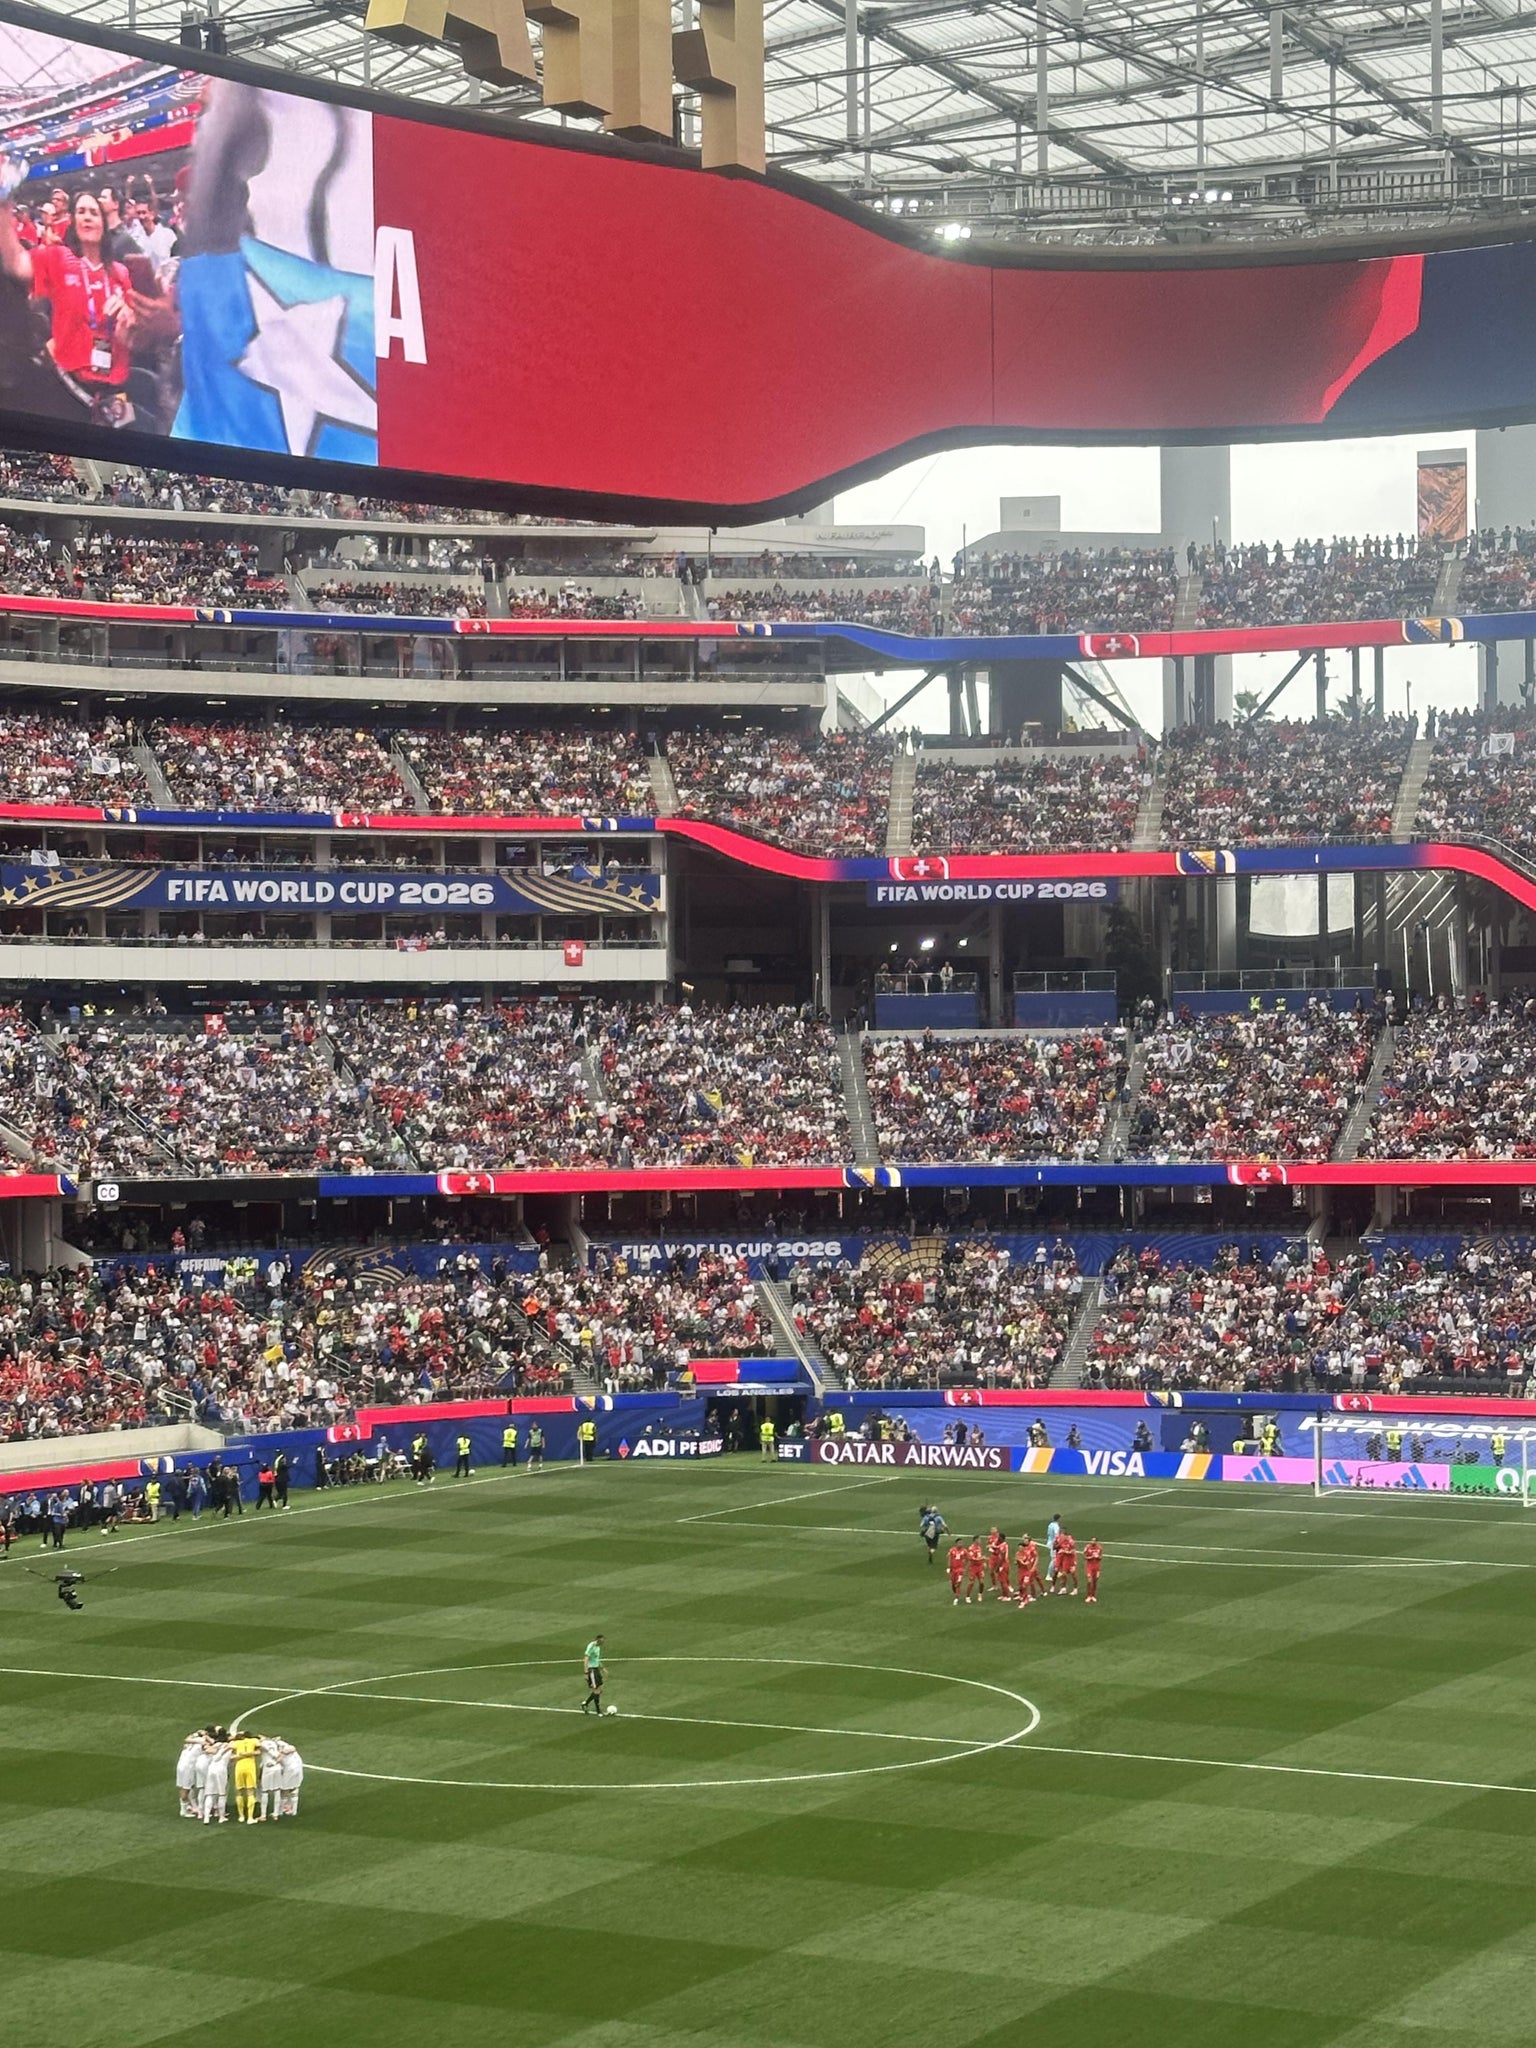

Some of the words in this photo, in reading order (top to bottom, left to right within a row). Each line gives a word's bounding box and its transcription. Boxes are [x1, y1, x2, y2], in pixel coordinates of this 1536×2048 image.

[374, 225, 427, 364] A
[167, 879, 229, 902] FIFA
[232, 880, 335, 903] WORLD
[339, 882, 394, 904] CUP
[399, 883, 495, 905] 2026
[876, 885, 918, 901] FIFA
[921, 883, 992, 900] WORLD
[995, 883, 1035, 899] CUP
[1037, 882, 1107, 899] 2026
[100, 1187, 117, 1198] CC
[621, 1243, 661, 1260] FIFA
[735, 1242, 773, 1257] CUP
[776, 1240, 842, 1257] 2026
[716, 1389, 740, 1397] LOS
[741, 1388, 794, 1396] ANGELES
[1298, 1416, 1382, 1434] FIFA
[632, 1439, 675, 1457] ADI
[819, 1441, 895, 1466] QATAR
[904, 1444, 1001, 1468] AIRWAYS
[1078, 1449, 1146, 1477] VISA
